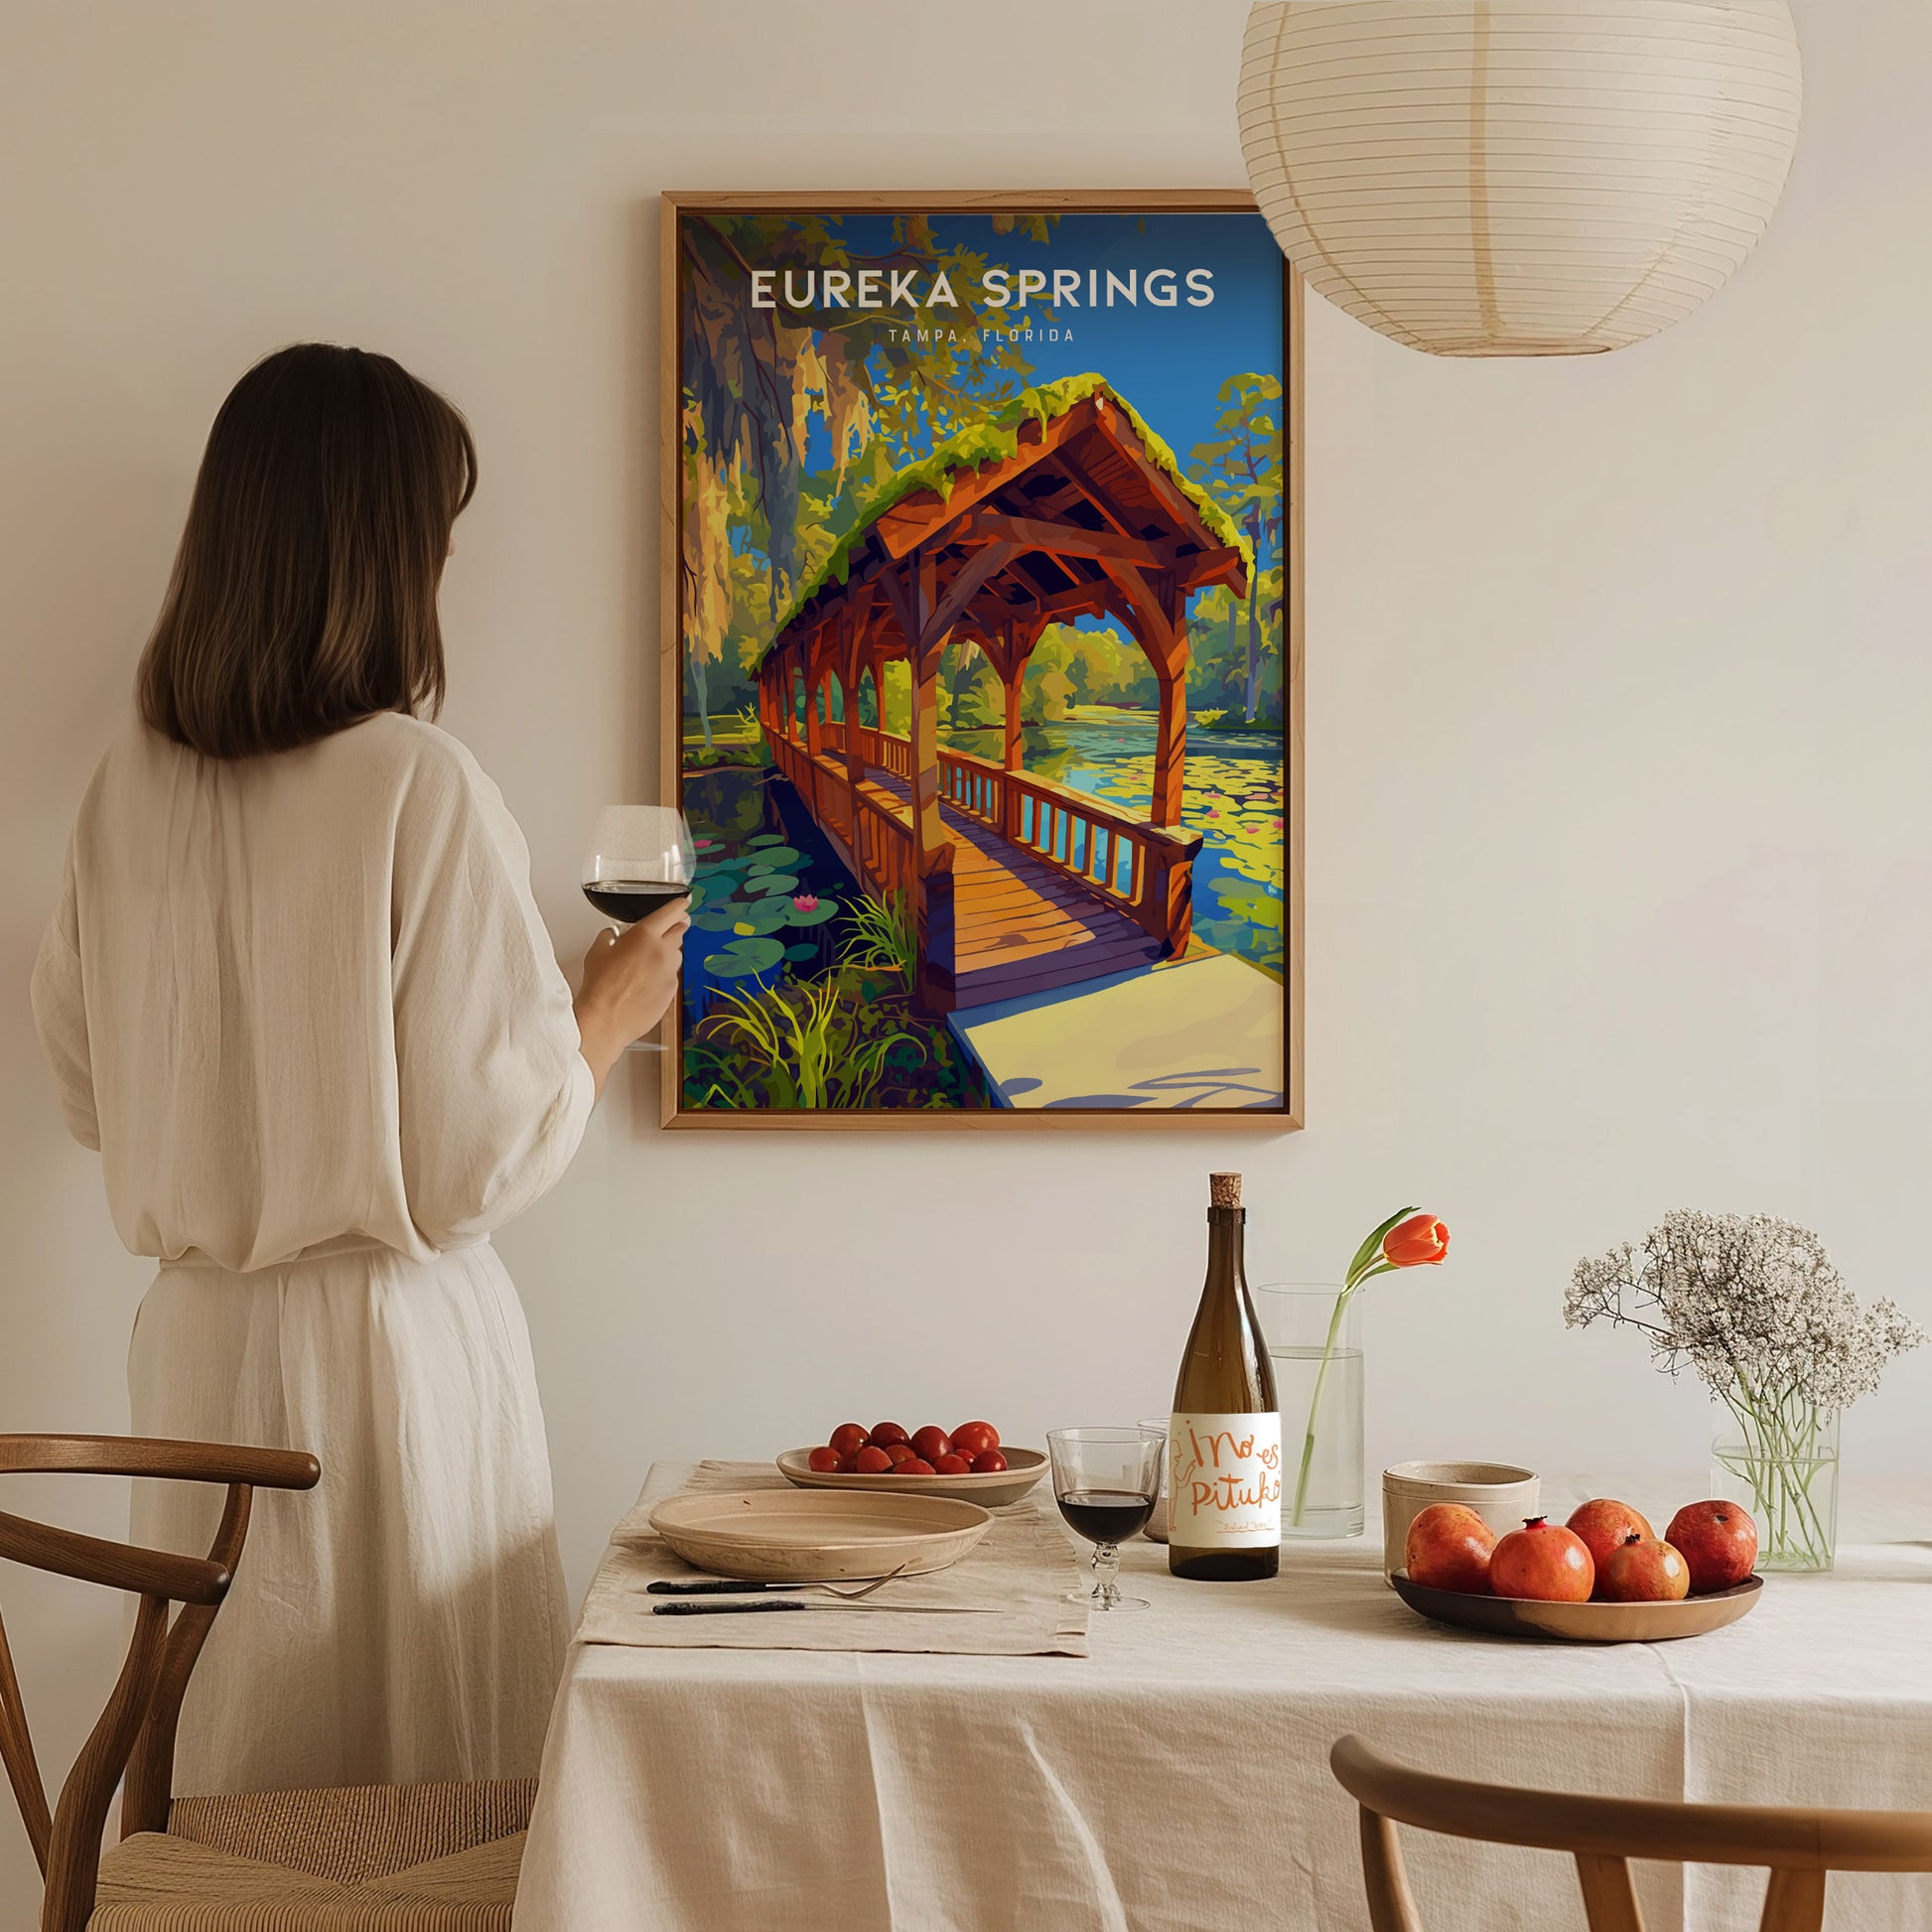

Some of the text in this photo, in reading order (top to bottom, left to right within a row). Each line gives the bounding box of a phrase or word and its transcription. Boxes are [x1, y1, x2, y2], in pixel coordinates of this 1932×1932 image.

[751, 267, 1215, 309] EUREKA SPRINGS
[889, 329, 1074, 344] TAMPA, FLORIDA
